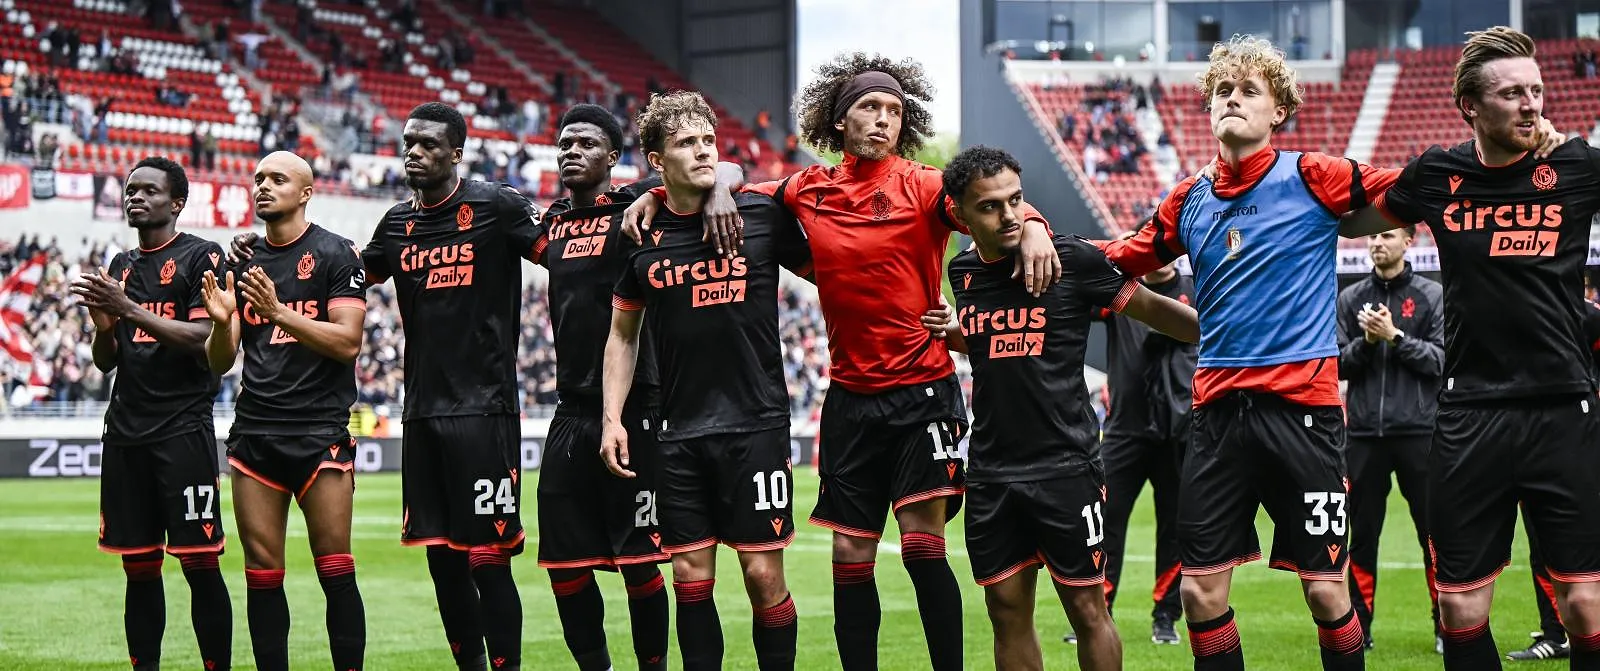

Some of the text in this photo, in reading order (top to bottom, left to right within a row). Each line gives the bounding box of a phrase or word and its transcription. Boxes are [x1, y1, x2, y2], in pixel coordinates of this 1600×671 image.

[548, 215, 612, 241] Circus
[1212, 205, 1258, 221] macron
[1443, 200, 1563, 232] Circus
[400, 244, 474, 272] Circus
[568, 237, 600, 257] Daily
[1498, 231, 1550, 256] Daily
[431, 266, 467, 287] Daily
[647, 256, 748, 289] Circus
[698, 281, 741, 303] Daily
[958, 304, 1047, 337] Circus
[995, 334, 1037, 356] Daily
[183, 485, 215, 521] 17
[474, 477, 516, 515] 24
[752, 470, 789, 511] 10
[1081, 501, 1105, 547] 11
[1304, 491, 1347, 536] 33
